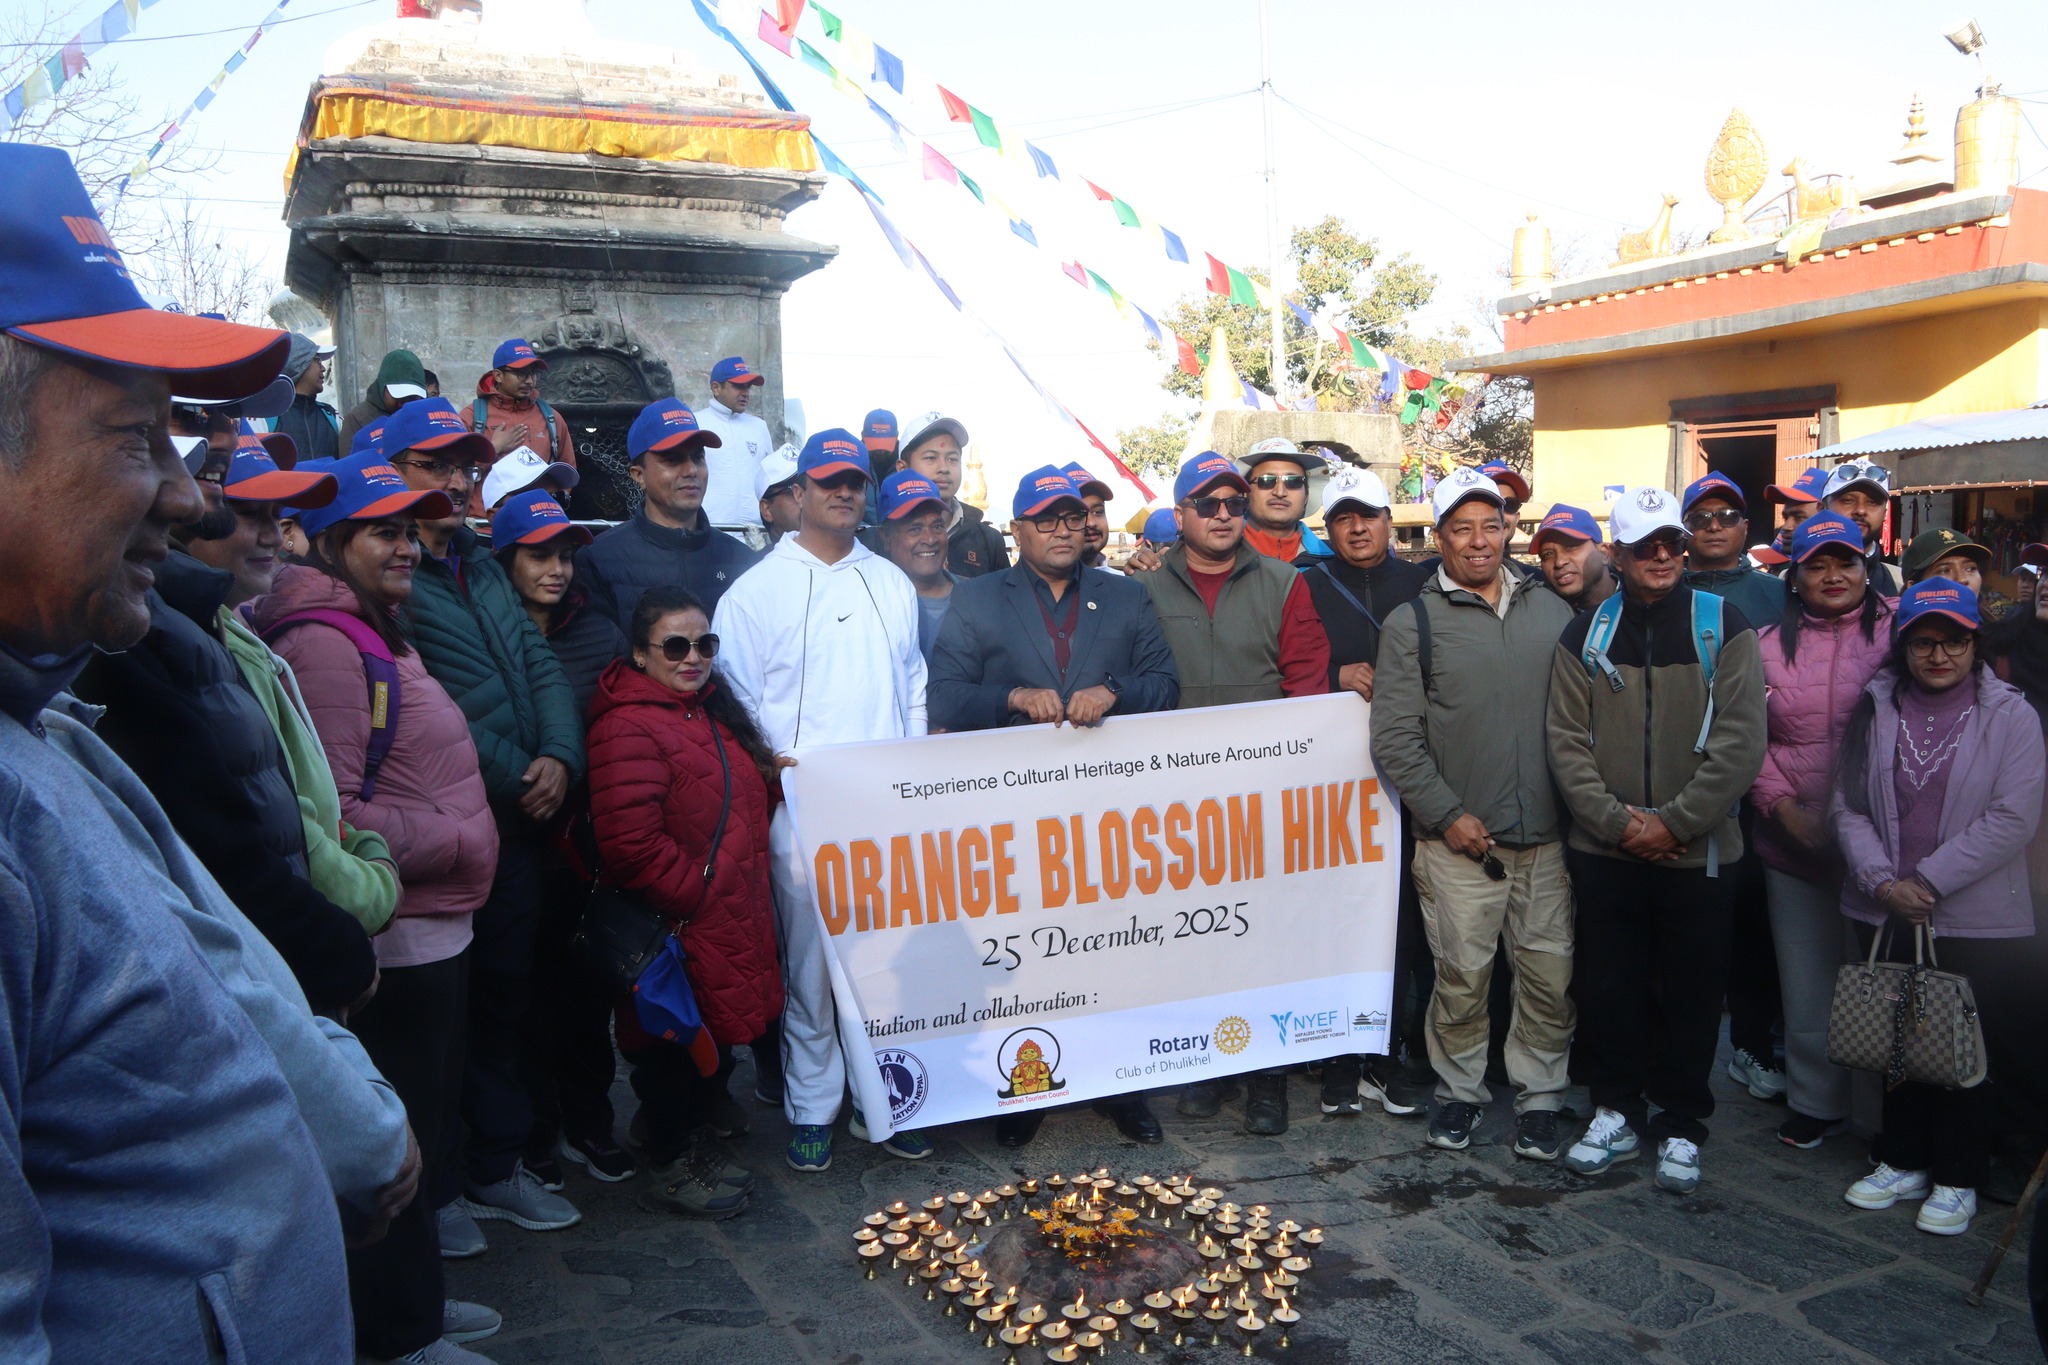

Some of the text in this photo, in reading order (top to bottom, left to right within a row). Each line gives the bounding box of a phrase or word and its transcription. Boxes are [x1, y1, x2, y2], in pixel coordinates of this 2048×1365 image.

[1916, 589, 1959, 600] DHULIKHEL
[892, 738, 1313, 800] "Experience Cultural Heritage & Nature Around Us"
[814, 776, 1384, 936] ORANGE BLOSSOM HIKE
[982, 902, 1249, 971] 25 December, 2025
[863, 1015, 928, 1038] itiation
[932, 1002, 968, 1028] and
[972, 991, 1088, 1022] collaboration
[1294, 1010, 1339, 1031] NYEF
[1149, 1034, 1210, 1056] Rotary
[1330, 1031, 1346, 1039] FORUM
[1115, 1053, 1212, 1080] Club of Dhulikhel
[893, 1073, 924, 1120] IATION NEPAL
[997, 1090, 1070, 1107] Dhulikhel Tourism Council
